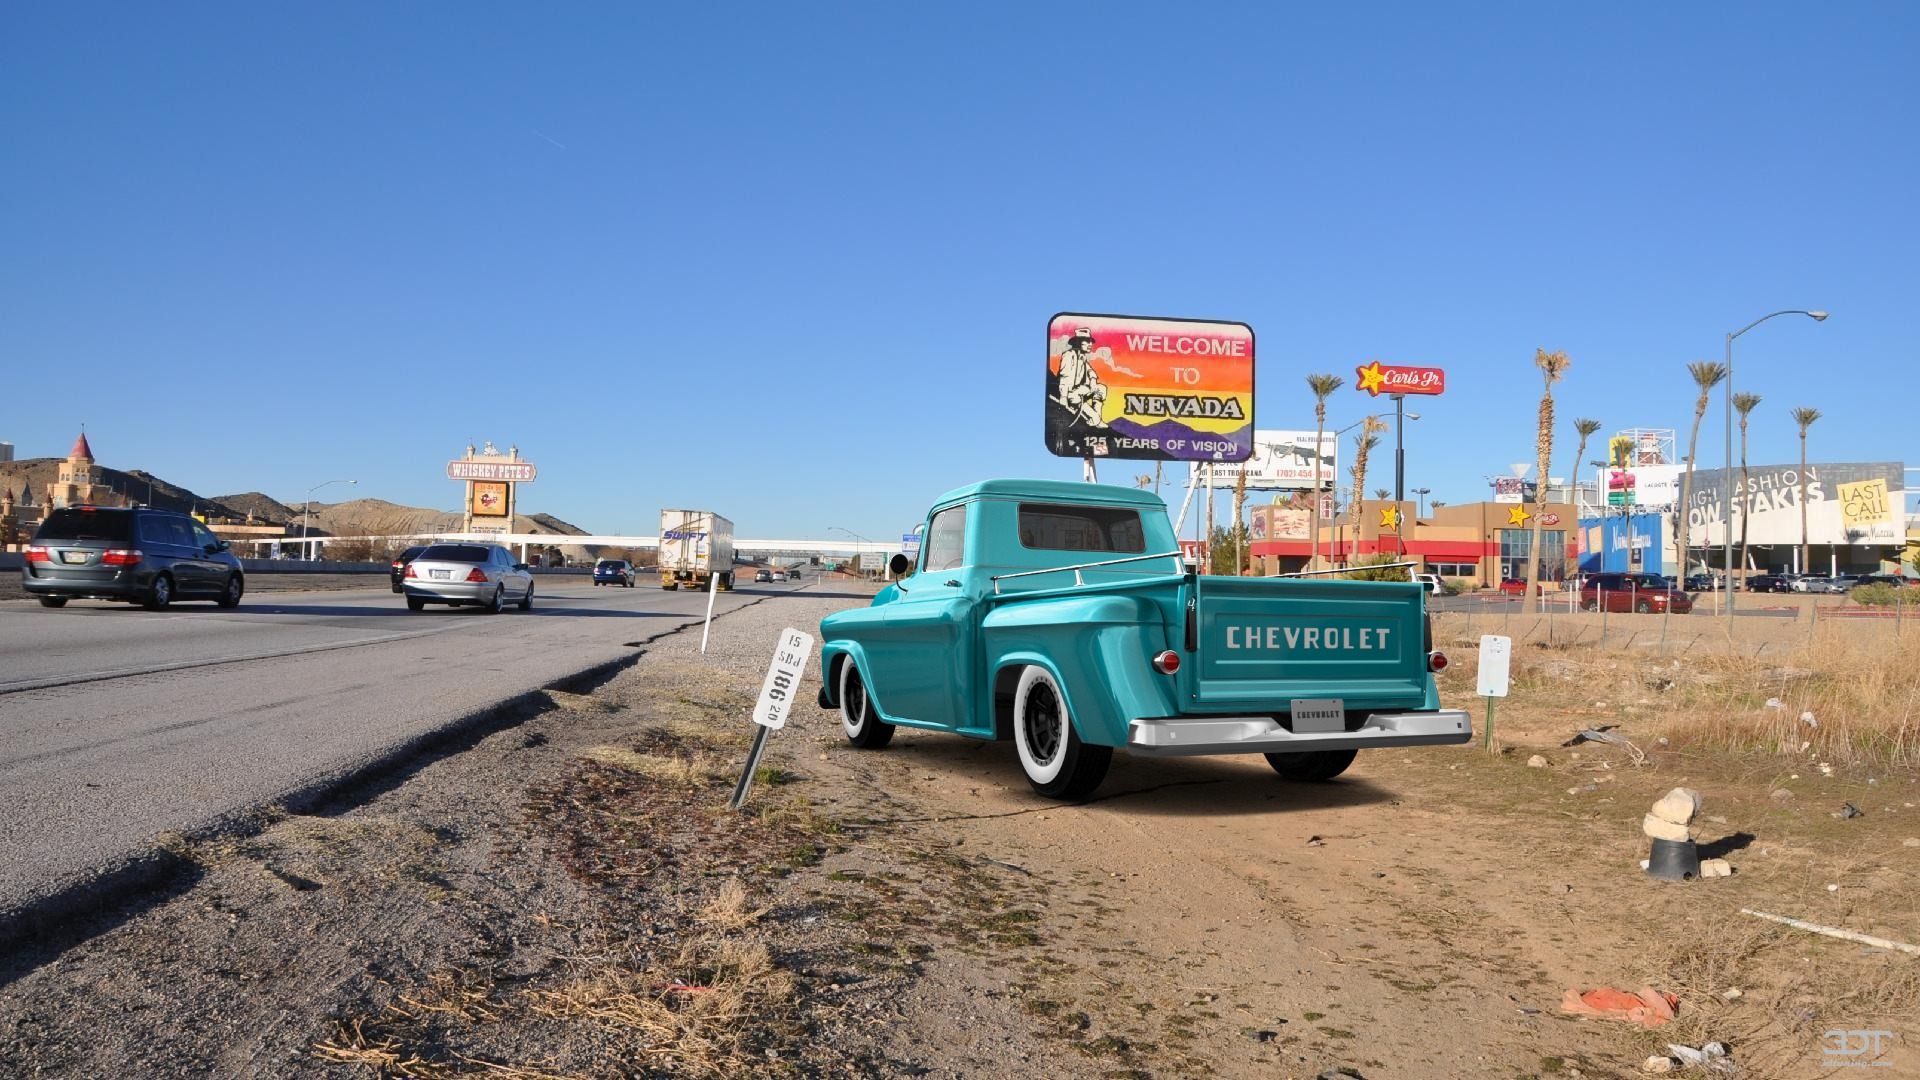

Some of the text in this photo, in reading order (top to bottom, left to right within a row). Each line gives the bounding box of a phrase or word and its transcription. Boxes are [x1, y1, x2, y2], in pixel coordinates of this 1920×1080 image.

[1126, 334, 1246, 357] WELCOME
[1170, 367, 1201, 385] TO
[1383, 369, 1442, 387] Carl's Jr.
[1125, 394, 1244, 419] NEVADA
[1083, 437, 1238, 452] 125 YEARS OF VISION
[452, 463, 531, 479] WHISKEY PETE'S
[1297, 469, 1332, 479] 454-10
[1735, 466, 1818, 496] ASHION
[1841, 483, 1882, 503] LAST
[1689, 501, 1721, 528] OW
[1844, 499, 1888, 517] CALL
[663, 530, 708, 541] SWIFT
[788, 634, 803, 648] 15
[1226, 626, 1390, 650] CHEVROLET
[768, 668, 794, 702] 186
[1296, 710, 1340, 719] CHEVROLET
